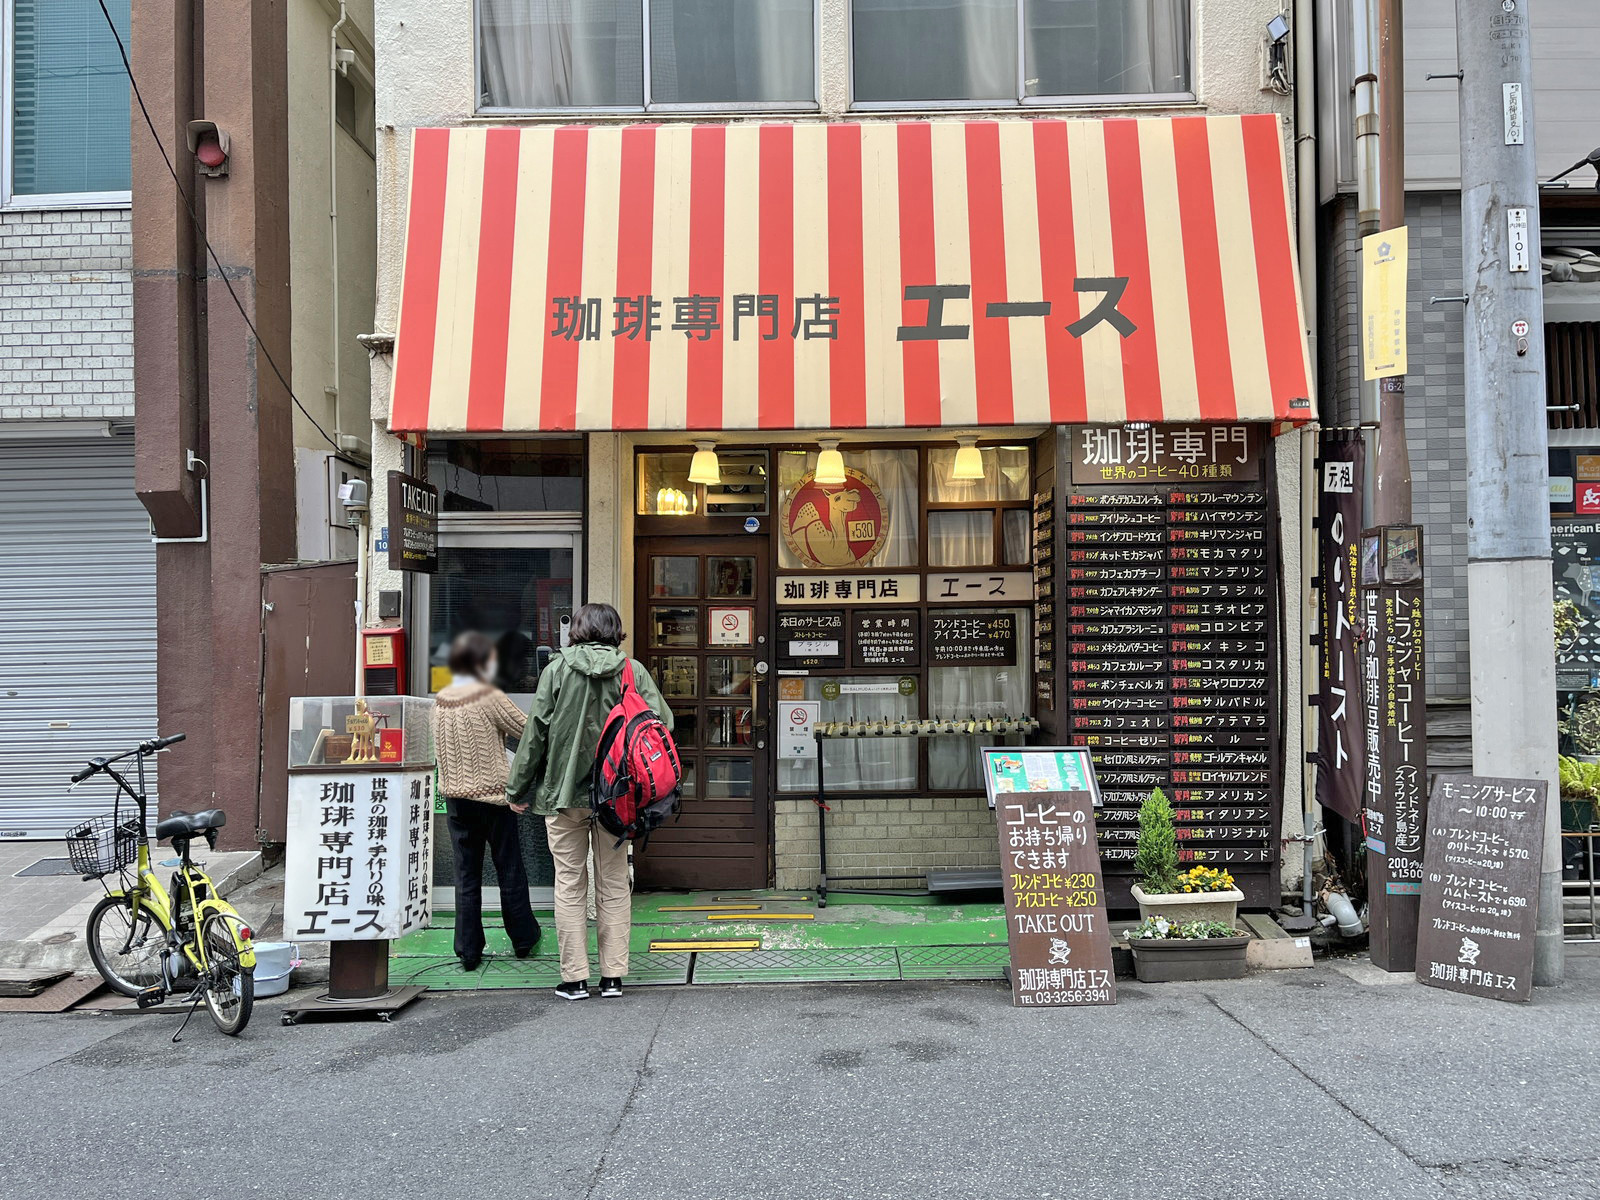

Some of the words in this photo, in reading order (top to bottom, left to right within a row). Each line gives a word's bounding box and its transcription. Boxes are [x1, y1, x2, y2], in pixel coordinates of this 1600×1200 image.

[552, 293, 840, 342] 珈琲専門店
[897, 277, 1138, 342] エース
[1082, 426, 1248, 464] 珈琲専門
[1100, 464, 1233, 480] 世界のコーヒー40種類
[1328, 467, 1353, 488] 元祖
[402, 482, 422, 513] TAKE
[421, 490, 437, 516] OUT
[1200, 493, 1262, 503] ブルーマウンテン
[1100, 514, 1160, 524] アイリッシュコーヒー
[1200, 512, 1262, 521] ハイマウンテン
[852, 522, 873, 539] ¥530
[1550, 523, 1594, 533] merican
[1200, 530, 1262, 540] キリマンジャロ
[378, 541, 388, 550] 10
[1200, 548, 1262, 558] モカマタリ
[1100, 569, 1160, 578] カフェカプチーノ
[1201, 567, 1264, 578] マンデリン
[784, 579, 899, 599] 珈琲専門店
[940, 577, 1006, 597] エース
[1100, 587, 1162, 596] カフェアレキサンダー
[1201, 586, 1264, 596] ブラジル
[1100, 606, 1162, 616] ジャマイカンマジック
[1201, 604, 1264, 614] エチオピア
[780, 616, 842, 628] 本日のサービス品
[933, 619, 986, 629] ブレンドコーヒー
[1201, 622, 1264, 632] コロンビア
[934, 629, 986, 640] アイスコーヒー
[1101, 642, 1163, 652] メキシカンバターコーヒー
[1202, 642, 1264, 652] メキシコ
[1102, 661, 1162, 671] カフェカルーア
[1202, 660, 1264, 670] コスタリカ
[1395, 589, 1413, 762] トラジャコーヒー
[1202, 678, 1265, 688] ジャワロブスタ
[1365, 589, 1381, 802] 世界の珈琲豆販売中
[1102, 698, 1163, 708] ウインナーコーヒー
[1203, 696, 1265, 706] サルバドル
[1104, 717, 1164, 728] カフェオレ
[1204, 716, 1266, 726] グァテマラ
[1104, 736, 1166, 746] コーヒーゼリー
[1204, 734, 1265, 744] ペルー
[1104, 754, 1166, 764] セイロン風ミルクティー
[1204, 753, 1267, 763] ゴールデンキャメル
[1104, 774, 1166, 784] ソフィア風ミルクティー
[1202, 772, 1268, 782] ロイヤルブレンド
[1204, 790, 1268, 800] アメリカン
[1442, 782, 1537, 804] モーニングサービス
[1005, 804, 1086, 826] コーヒーの
[1206, 809, 1268, 820] イタリアン
[1009, 825, 1087, 848] お持ち帰り
[1206, 828, 1268, 838] オリジナル
[316, 782, 355, 907] 珈琲専門店
[365, 777, 389, 906] 世界の珈琲・手作りの味
[406, 779, 422, 902] 珈琲専門店
[1010, 848, 1070, 870] できます
[1208, 850, 1268, 860] ブレンド
[1010, 873, 1062, 891] ブレンドコーヒー
[1064, 873, 1095, 890] ¥230
[1014, 892, 1064, 908] アイスコーヒー
[1066, 891, 1097, 907] ¥250
[403, 899, 429, 930] エース
[296, 909, 386, 935] エース
[1014, 914, 1056, 934] TAKE
[1060, 914, 1094, 932] OUT
[1018, 968, 1086, 991] 珈琲専門店
[1088, 969, 1112, 988] エース
[1430, 962, 1494, 988] 珈琲専門店
[1495, 974, 1517, 990] エース
[1020, 994, 1034, 1004] TEL
[1036, 989, 1110, 1004] 03-3256-3941
